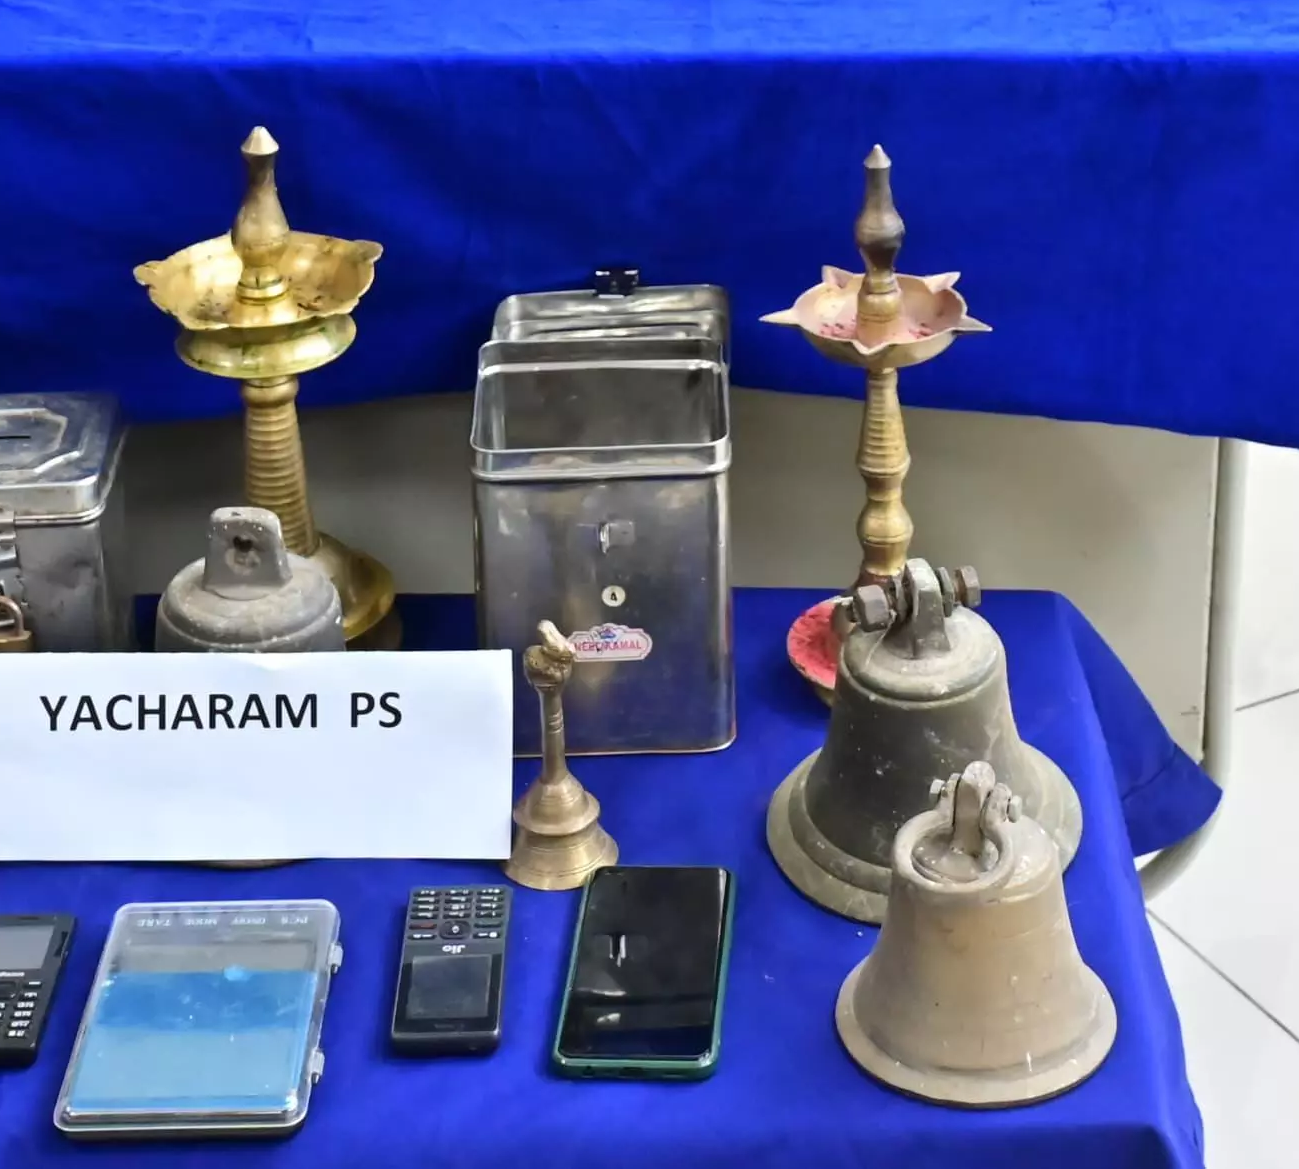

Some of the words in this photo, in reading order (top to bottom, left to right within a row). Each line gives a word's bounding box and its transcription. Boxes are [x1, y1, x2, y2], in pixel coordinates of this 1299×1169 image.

[39, 692, 318, 731] YACHARAM
[350, 691, 402, 729] PS
[442, 944, 466, 954] Jio
